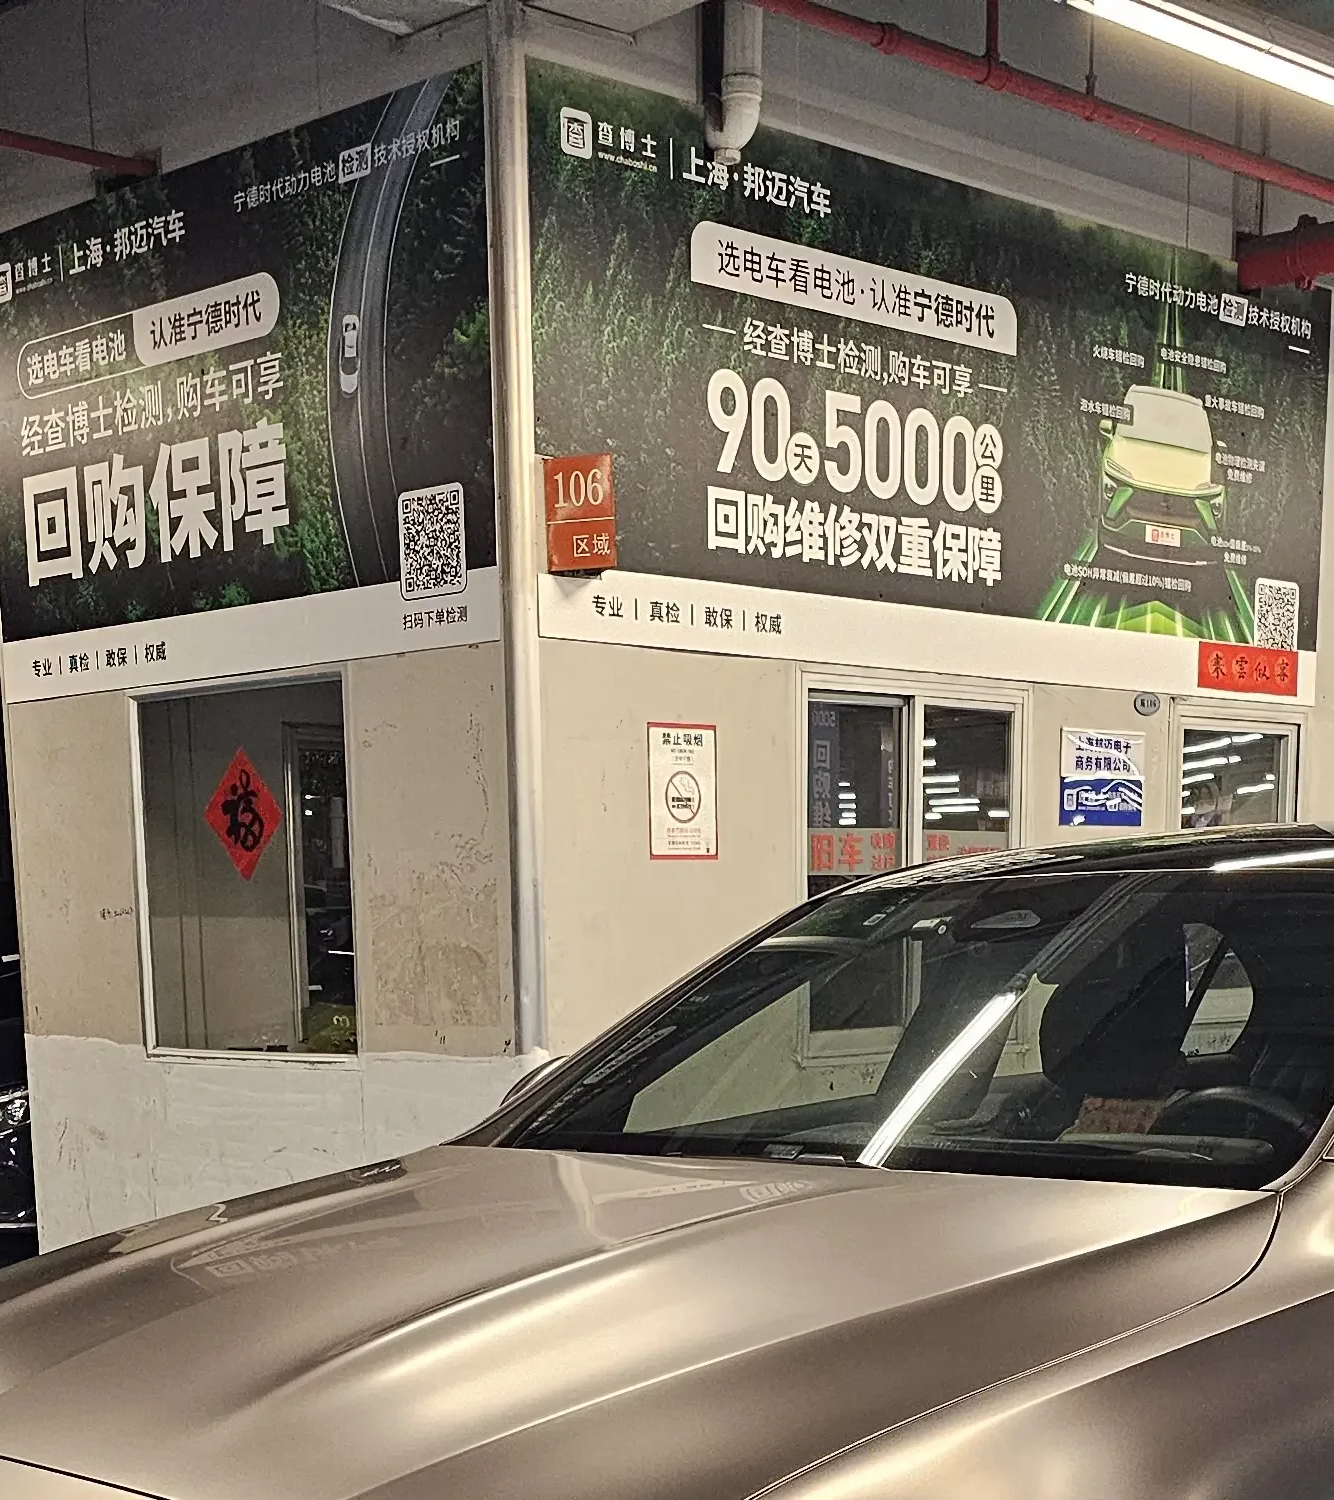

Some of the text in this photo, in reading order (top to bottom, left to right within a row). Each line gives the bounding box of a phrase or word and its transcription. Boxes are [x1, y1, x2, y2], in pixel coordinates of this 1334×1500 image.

[597, 121, 657, 158] 查博士
[14, 252, 52, 283] 查博士
[27, 289, 262, 387] 选电车看电池 认准宁德时代
[23, 417, 289, 587] 回购保障
[553, 468, 604, 508] 106
[572, 532, 611, 558] 区域
[707, 485, 1002, 587] 回购维修双重保障
[402, 604, 468, 631] 扫码下单检测
[592, 594, 783, 635] 专业 真检 敢保 权威
[31, 641, 167, 678] 专业 真检 敢保 权威
[662, 732, 703, 747] 禁止吸烟
